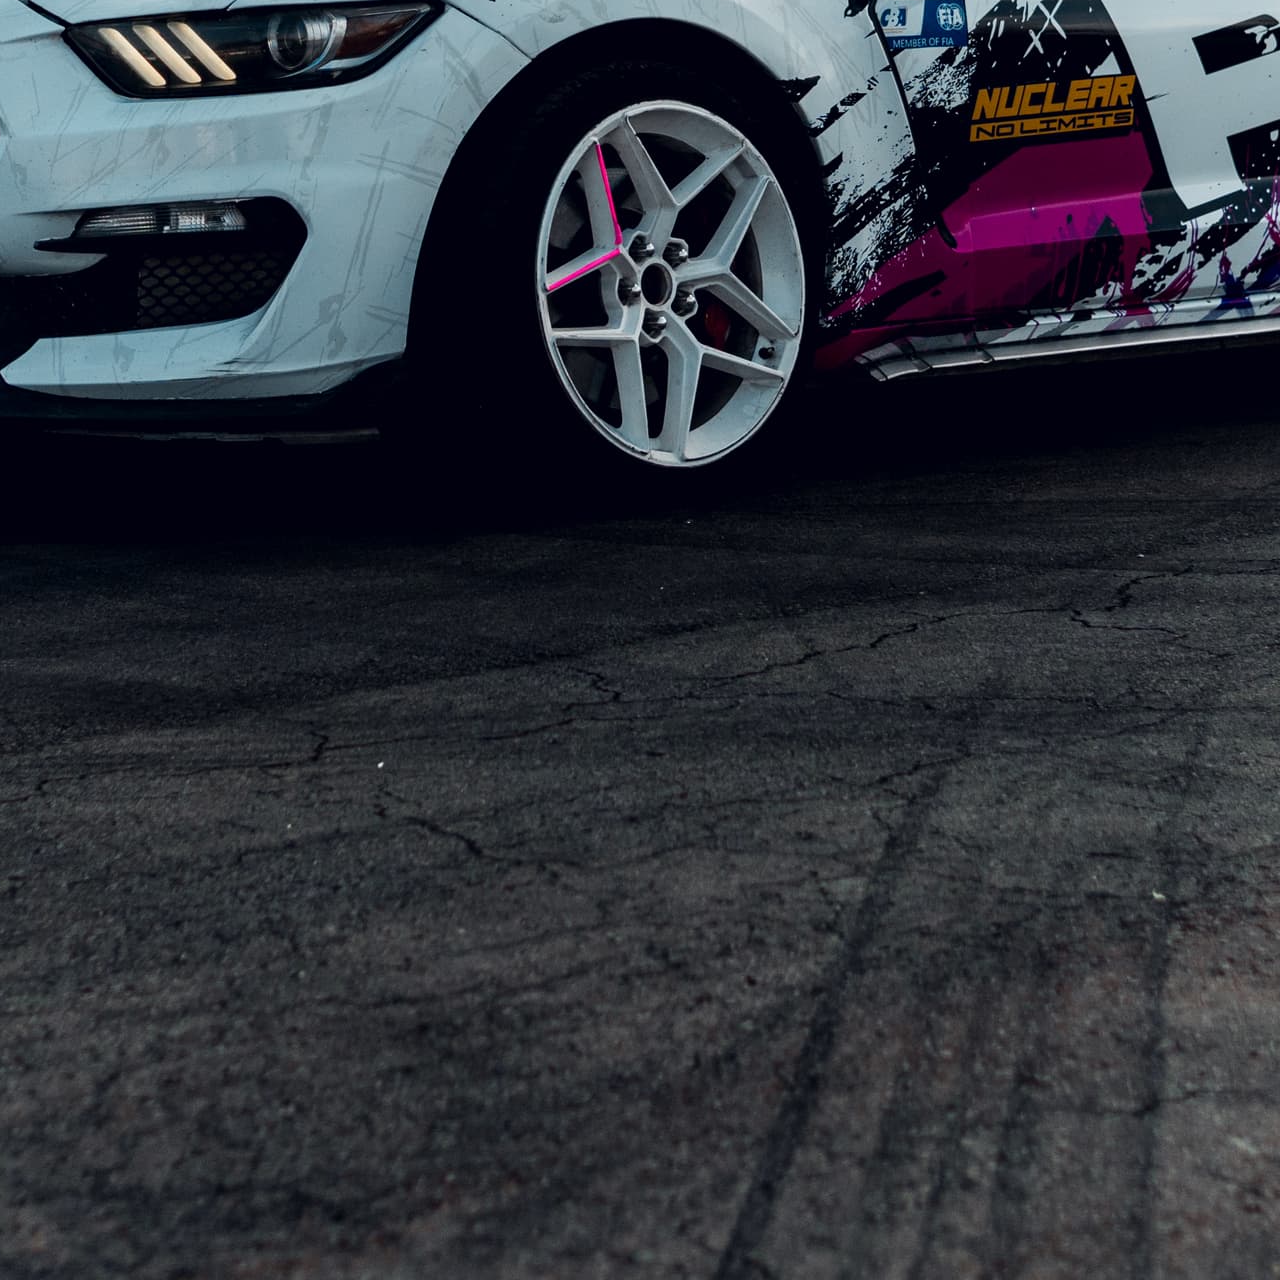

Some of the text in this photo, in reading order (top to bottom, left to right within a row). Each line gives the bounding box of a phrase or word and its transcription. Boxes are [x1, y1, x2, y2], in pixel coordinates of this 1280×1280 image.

[893, 37, 955, 48] MEMBER OF FIA
[972, 75, 1136, 121] NUCLEAR
[976, 111, 1132, 140] NO LIMITS
